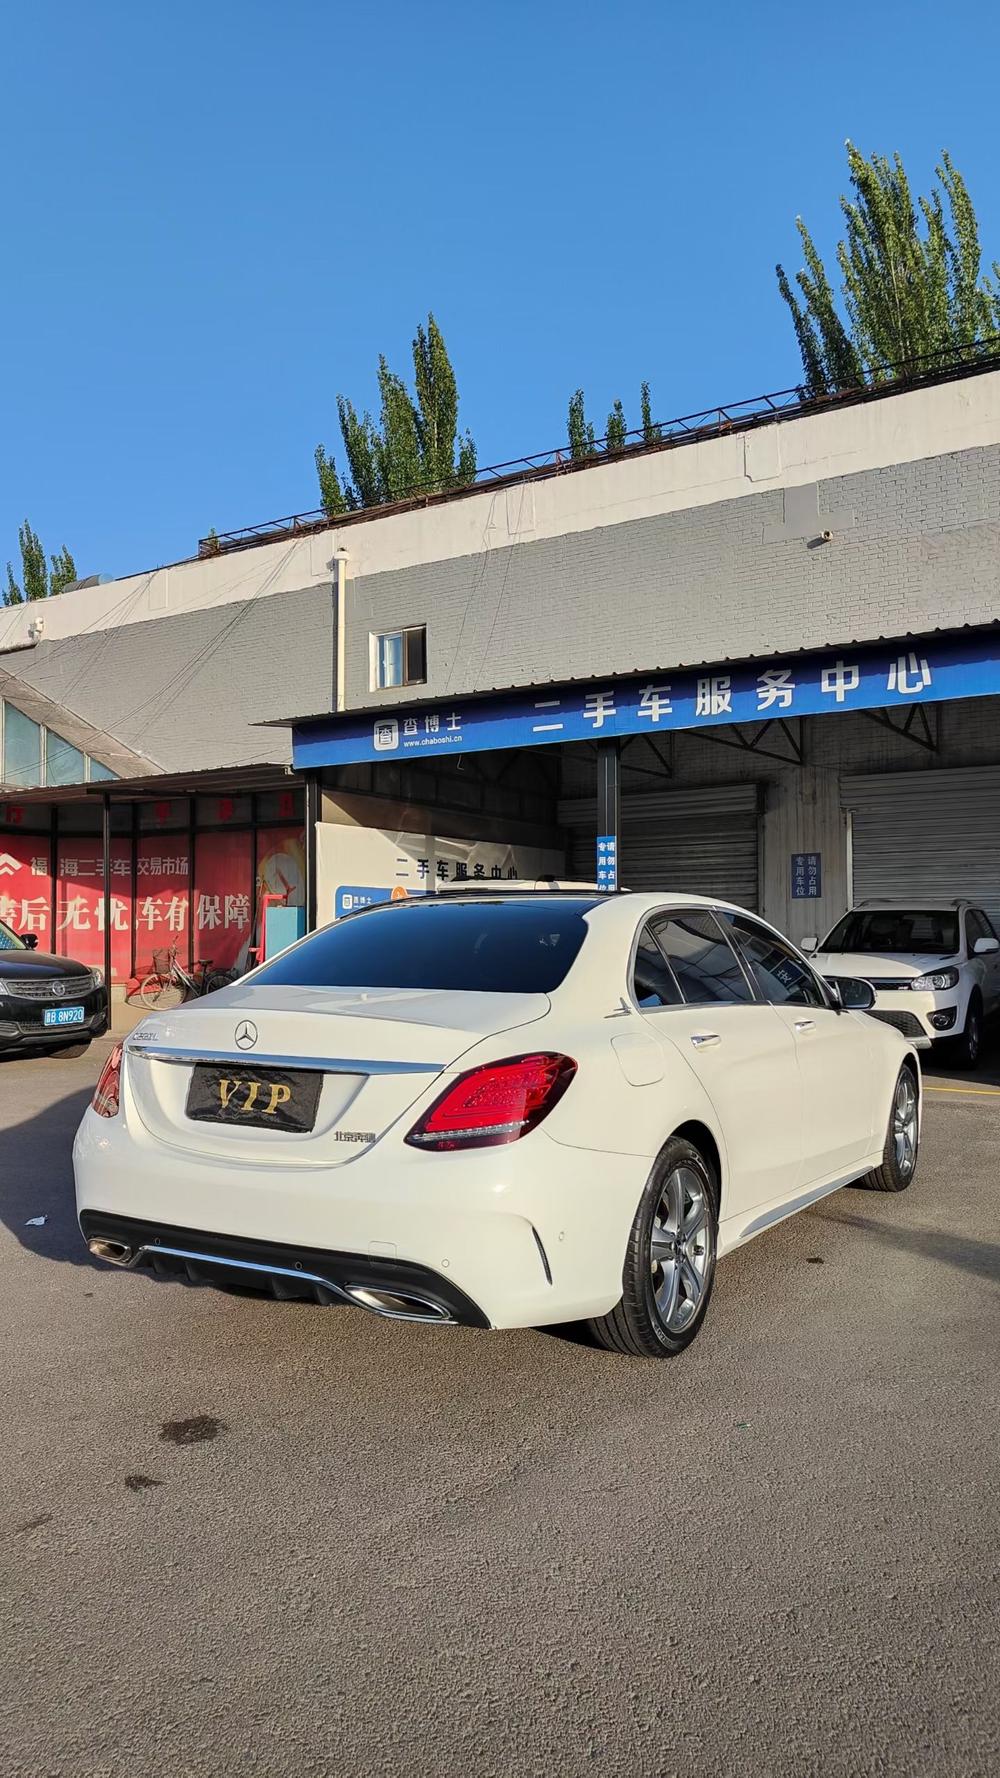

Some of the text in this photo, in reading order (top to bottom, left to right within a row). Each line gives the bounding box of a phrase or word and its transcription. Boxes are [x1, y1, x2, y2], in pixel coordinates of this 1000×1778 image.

[532, 652, 931, 732] 二手车服务中心
[403, 712, 461, 735] 查博士
[403, 735, 462, 747] www.chaboshi.cn
[795, 856, 817, 896] 专用车位 请勿占用
[219, 1079, 291, 1115] VIP
